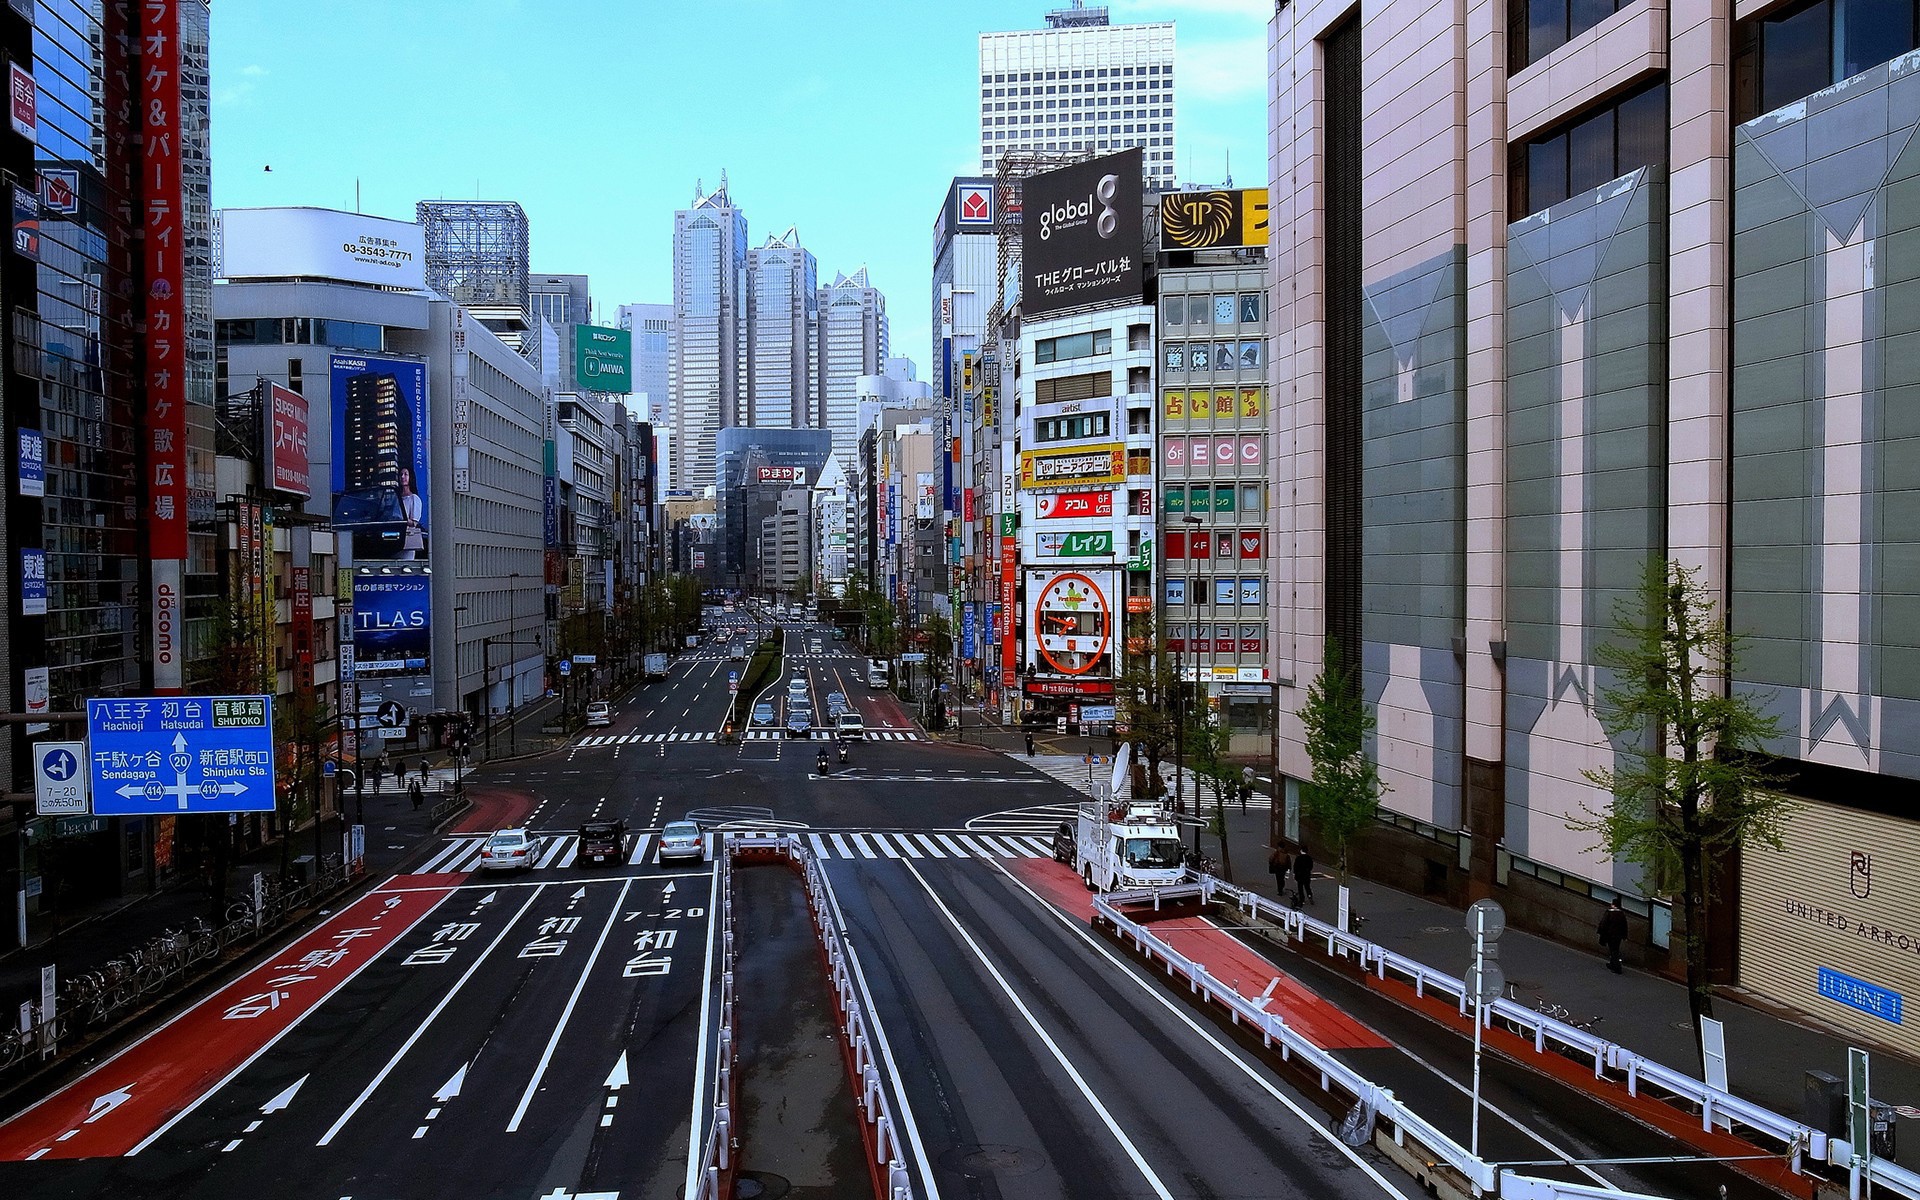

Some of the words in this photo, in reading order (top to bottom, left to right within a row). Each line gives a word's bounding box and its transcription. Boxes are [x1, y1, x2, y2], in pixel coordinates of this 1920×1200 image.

[1040, 194, 1093, 241] global
[1063, 221, 1075, 229] Global
[343, 243, 412, 261] 03-3543-7771
[1044, 283, 1074, 296] ウィルローズ
[1077, 275, 1121, 289] マンションシリーズ
[600, 363, 625, 375] MIWA
[154, 309, 175, 520] カラオケ歌広場
[275, 397, 295, 418] SUPER
[21, 434, 42, 462] 東進
[944, 440, 952, 452] For
[1168, 445, 1183, 459] 6F
[1193, 443, 1258, 462] ECC
[760, 468, 792, 479] やまや
[1004, 475, 1012, 496] アコム
[1065, 499, 1088, 510] アコム
[1098, 494, 1109, 504] 6F
[1141, 490, 1150, 514] アコム
[1071, 534, 1107, 552] レイク
[1142, 544, 1150, 568] レイク
[23, 553, 45, 579] 東進
[1003, 581, 1012, 602] First
[158, 584, 174, 664] docomo
[1003, 602, 1011, 636] Kitchen
[1216, 642, 1233, 652] ICT
[94, 703, 151, 720] 八王子
[161, 702, 202, 718] 初台
[215, 701, 262, 716] 首都高
[103, 721, 144, 732] Hachioji
[161, 720, 204, 730] Hatsudai
[217, 716, 261, 726] SHUTOKO
[382, 729, 402, 738] 7-20
[175, 757, 188, 767] 20
[199, 749, 269, 768] 新宿駅西口
[102, 769, 156, 780] Sendagaya
[202, 767, 245, 779] Shinjuku
[248, 766, 268, 776] Sta.
[46, 787, 77, 796] 7-20
[147, 785, 162, 796] 414
[202, 784, 217, 795] 414
[41, 798, 83, 808] この先50m
[624, 907, 704, 922] 7-20
[1785, 898, 1849, 932] UNITED
[622, 929, 678, 977] 初台
[1822, 972, 1886, 1014] LUMINE
